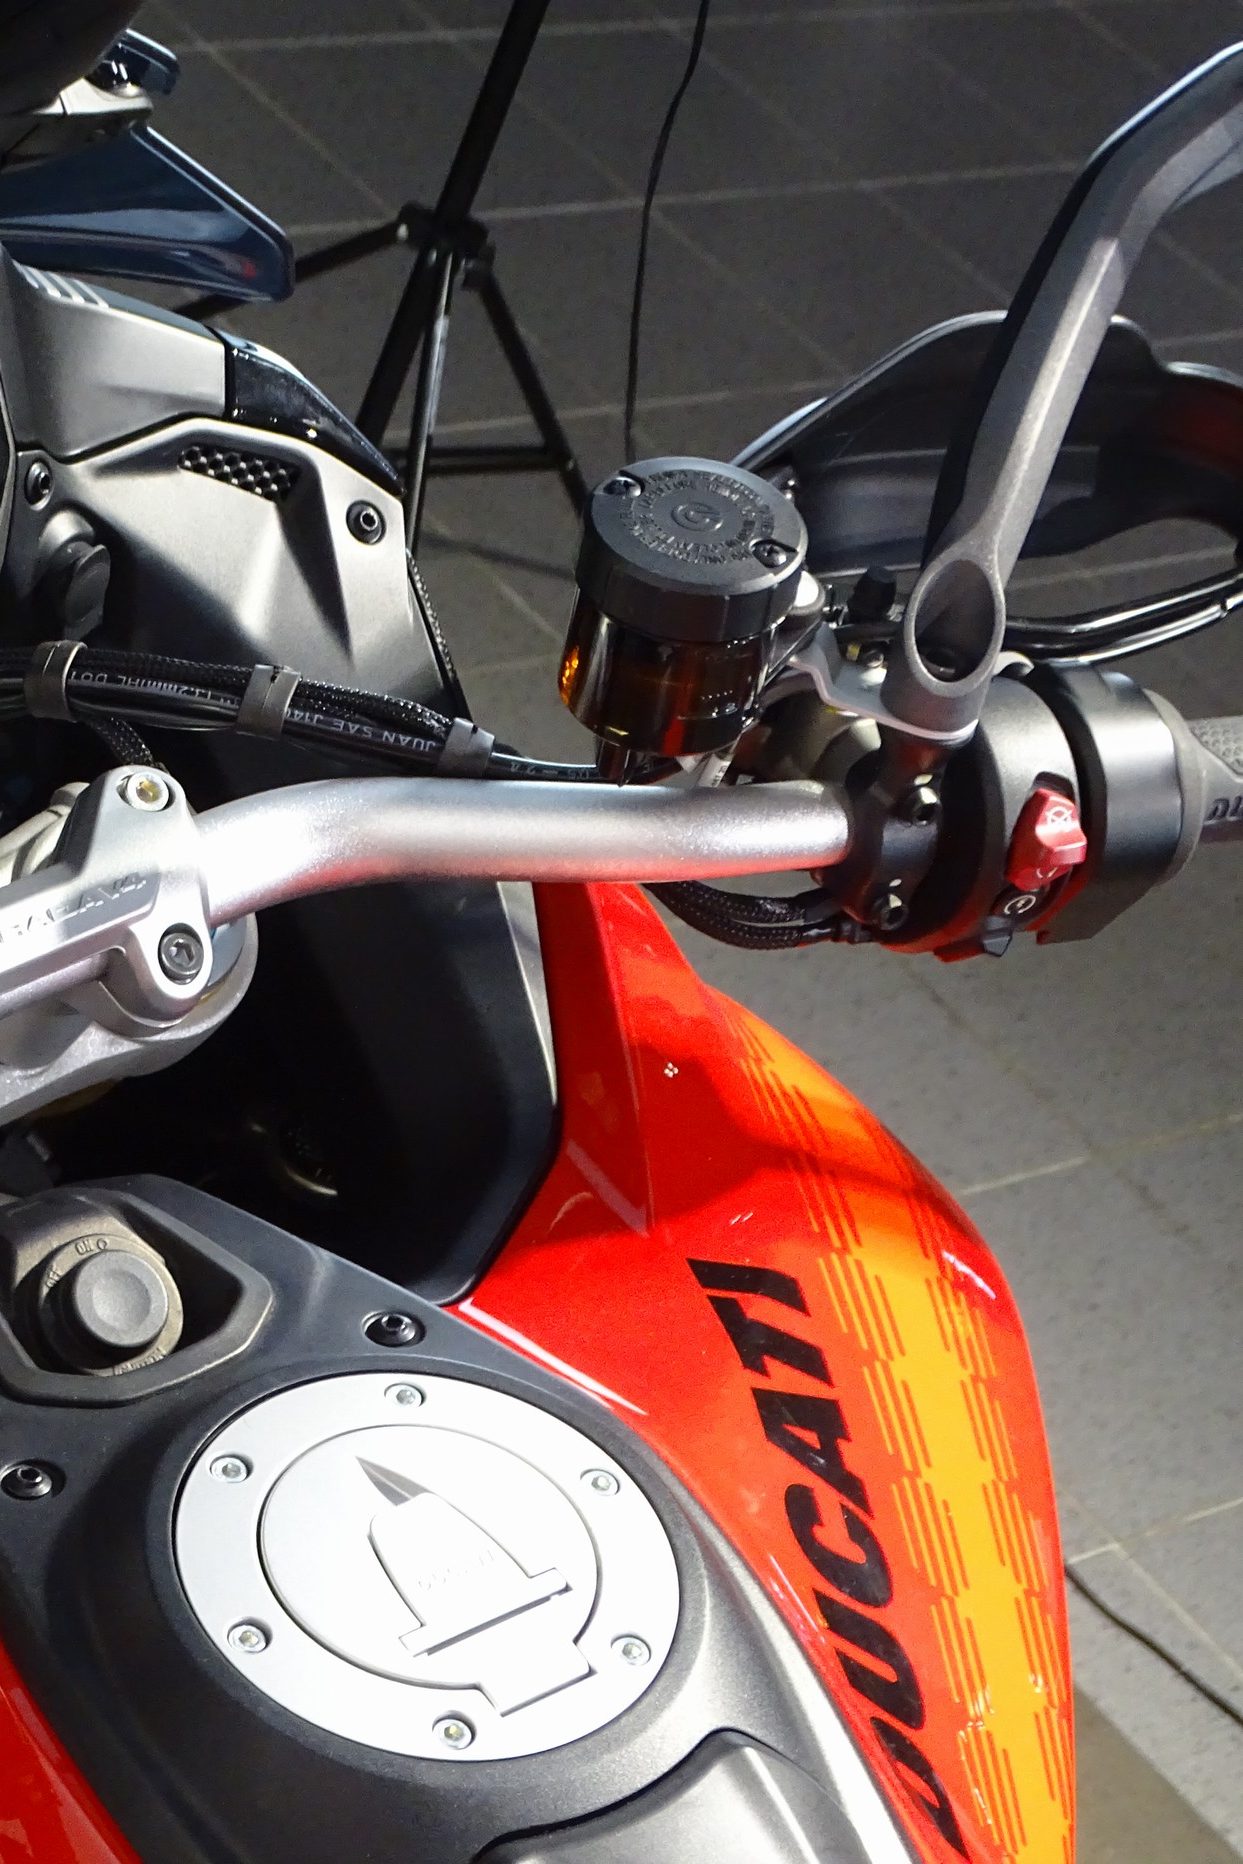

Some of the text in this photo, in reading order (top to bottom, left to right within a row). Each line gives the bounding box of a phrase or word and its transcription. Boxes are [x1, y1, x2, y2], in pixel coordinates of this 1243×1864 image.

[332, 718, 374, 738] SAE
[382, 730, 436, 752] JUAN
[686, 1258, 970, 1862] DUCATI
